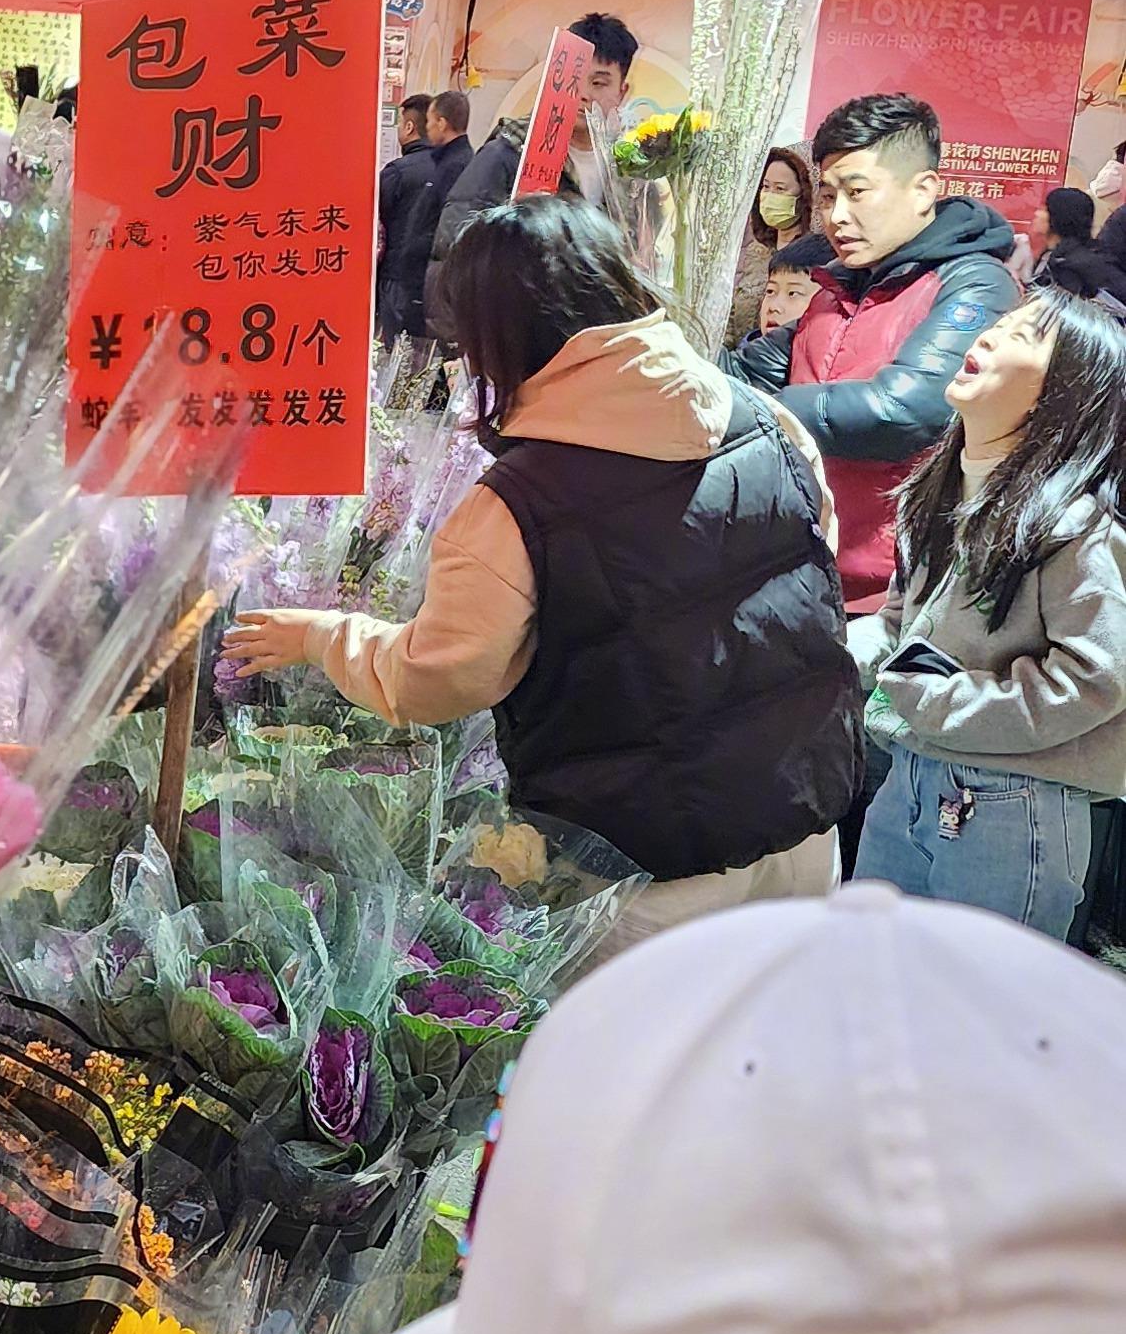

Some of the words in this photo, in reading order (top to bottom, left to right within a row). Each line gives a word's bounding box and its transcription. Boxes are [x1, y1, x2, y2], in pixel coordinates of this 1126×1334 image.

[995, 4, 1085, 36] FAIR
[825, 31, 923, 50] SHENZHEN
[927, 34, 994, 53] SPRING
[998, 39, 1084, 59] FESTIVAL
[155, 94, 282, 198] 财
[982, 146, 1061, 164] SHENZHEN
[984, 161, 1029, 174] FLOWER
[1031, 164, 1057, 176] FAIR
[193, 204, 351, 244] 紫气东来
[193, 244, 351, 281] 包你发财
